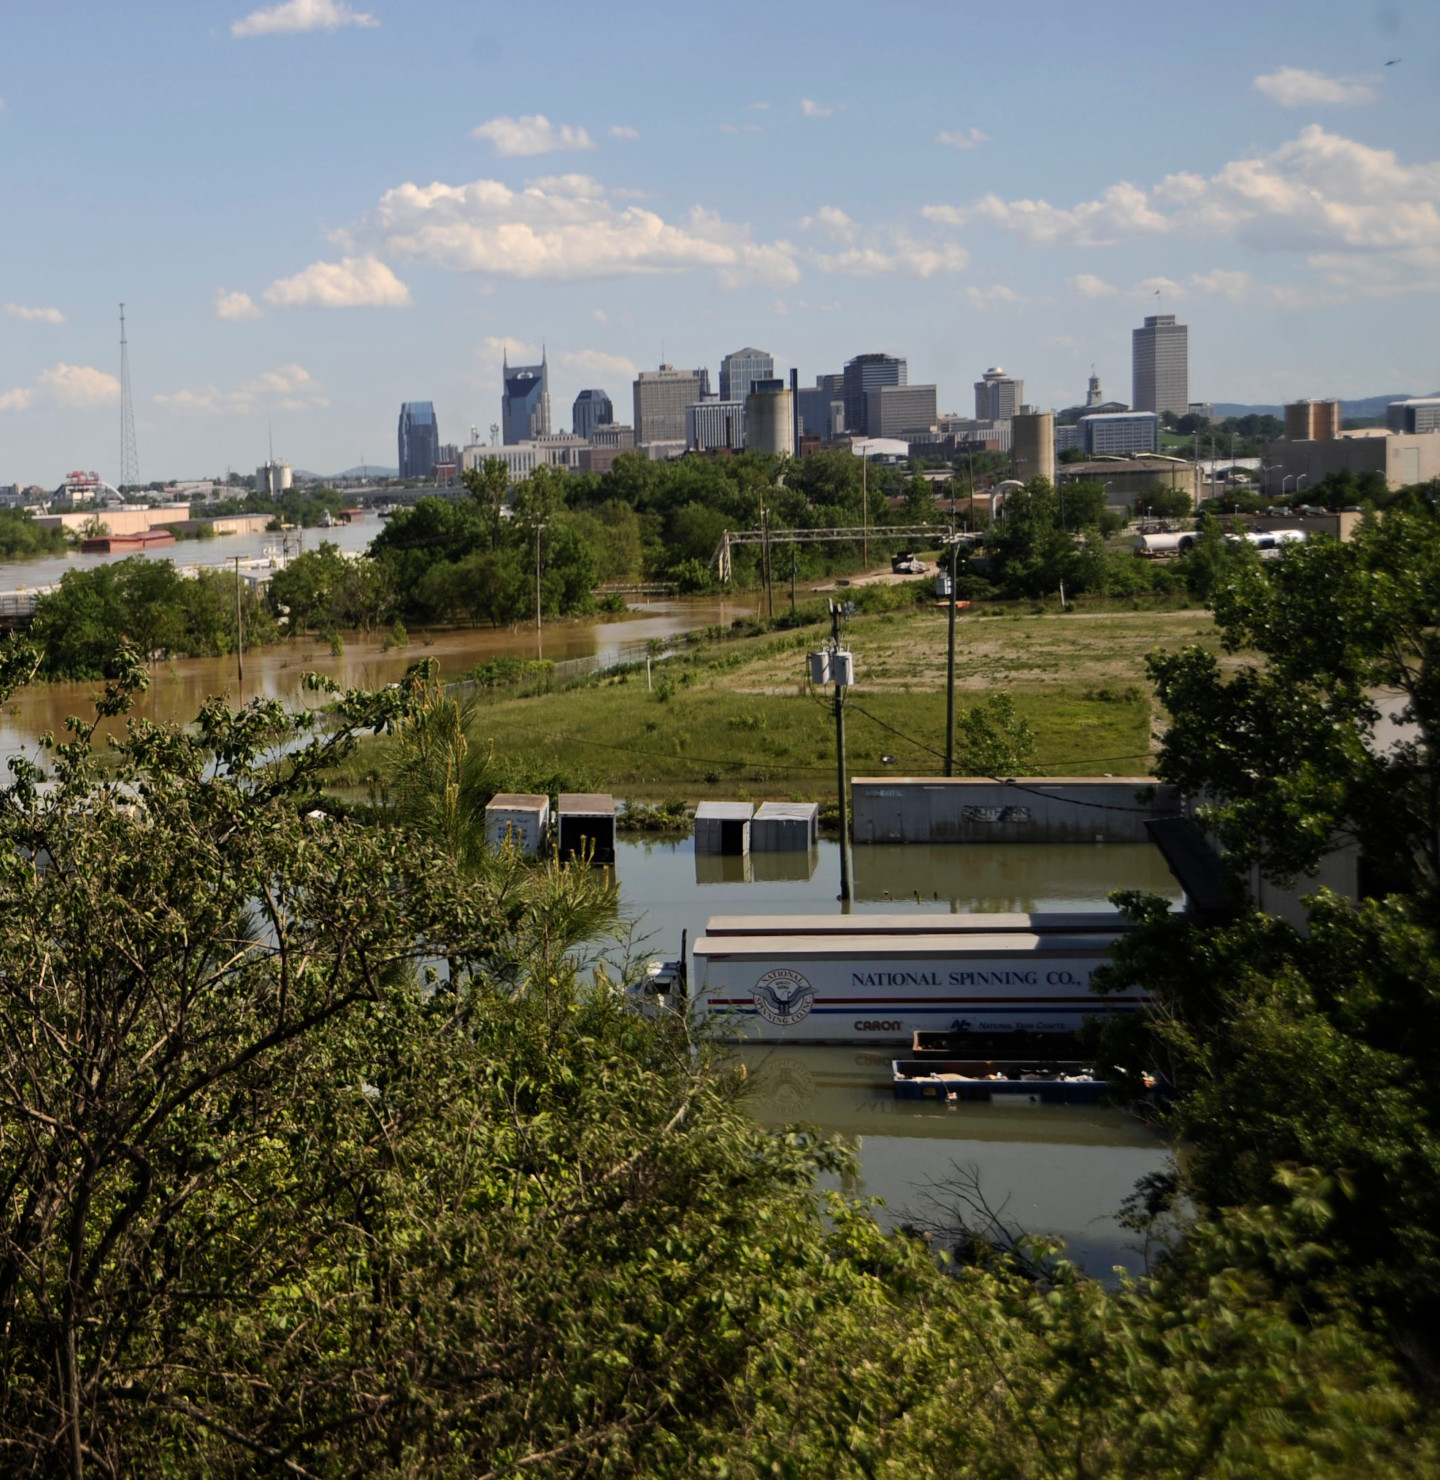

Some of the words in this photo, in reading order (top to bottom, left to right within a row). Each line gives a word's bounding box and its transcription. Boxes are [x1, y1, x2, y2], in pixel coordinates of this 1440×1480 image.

[762, 970, 804, 985] NATIONAL
[852, 972, 942, 986] NATIONAL
[948, 971, 1038, 985] SPINNING
[1046, 971, 1081, 987] CO.,
[854, 1020, 901, 1032] CARON
